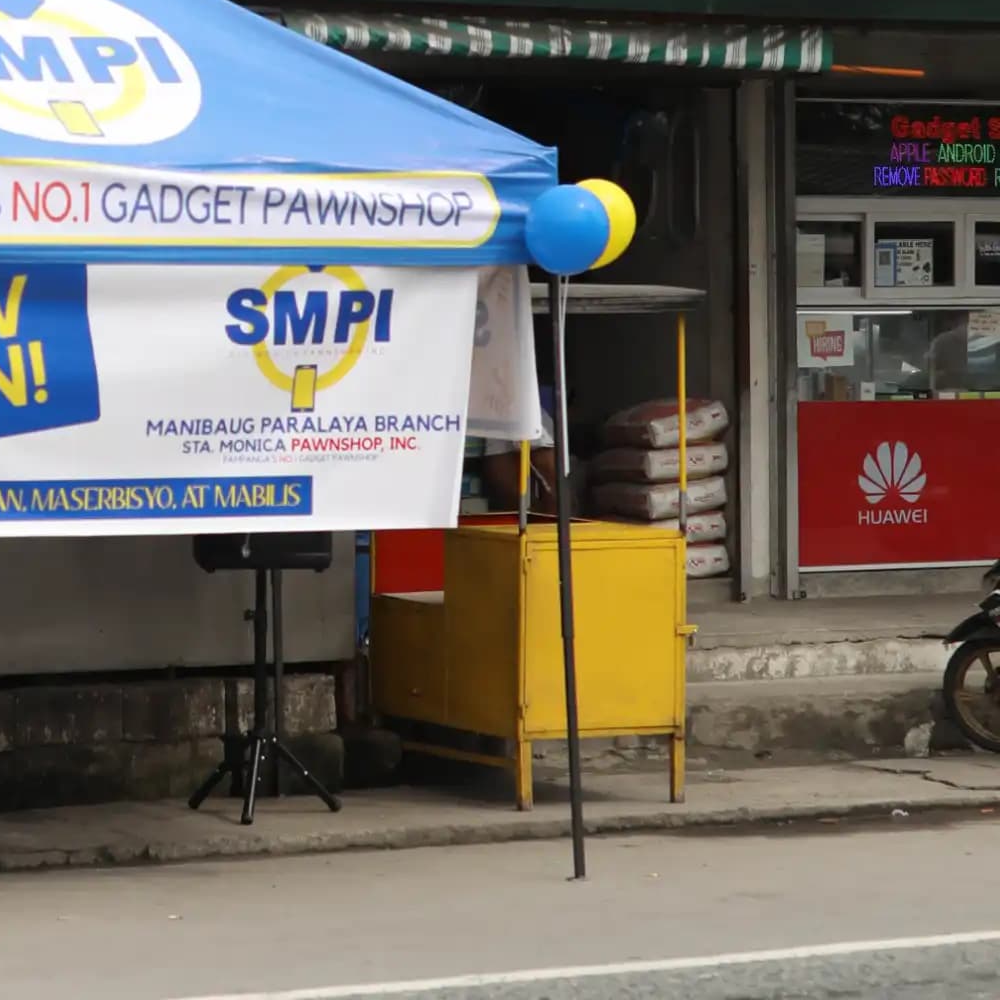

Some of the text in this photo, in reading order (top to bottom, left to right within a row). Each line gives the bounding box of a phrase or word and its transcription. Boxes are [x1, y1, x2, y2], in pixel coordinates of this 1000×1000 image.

[891, 115, 982, 143] Gadget
[890, 143, 996, 164] APPLE ANDROID
[873, 166, 921, 187] REMOVE
[12, 182, 90, 223] NO.1
[101, 182, 254, 225] GADGET
[263, 186, 474, 228] PAWNSHOP
[225, 288, 394, 346] SMPI
[146, 414, 461, 437] MANIBAUG PARALAYA BRANCH
[182, 436, 421, 454] STA. MONICA PAWNSHOP, INC.
[182, 484, 210, 509] AT
[214, 482, 301, 508] MABILIS
[858, 508, 928, 525] HUAWEI
